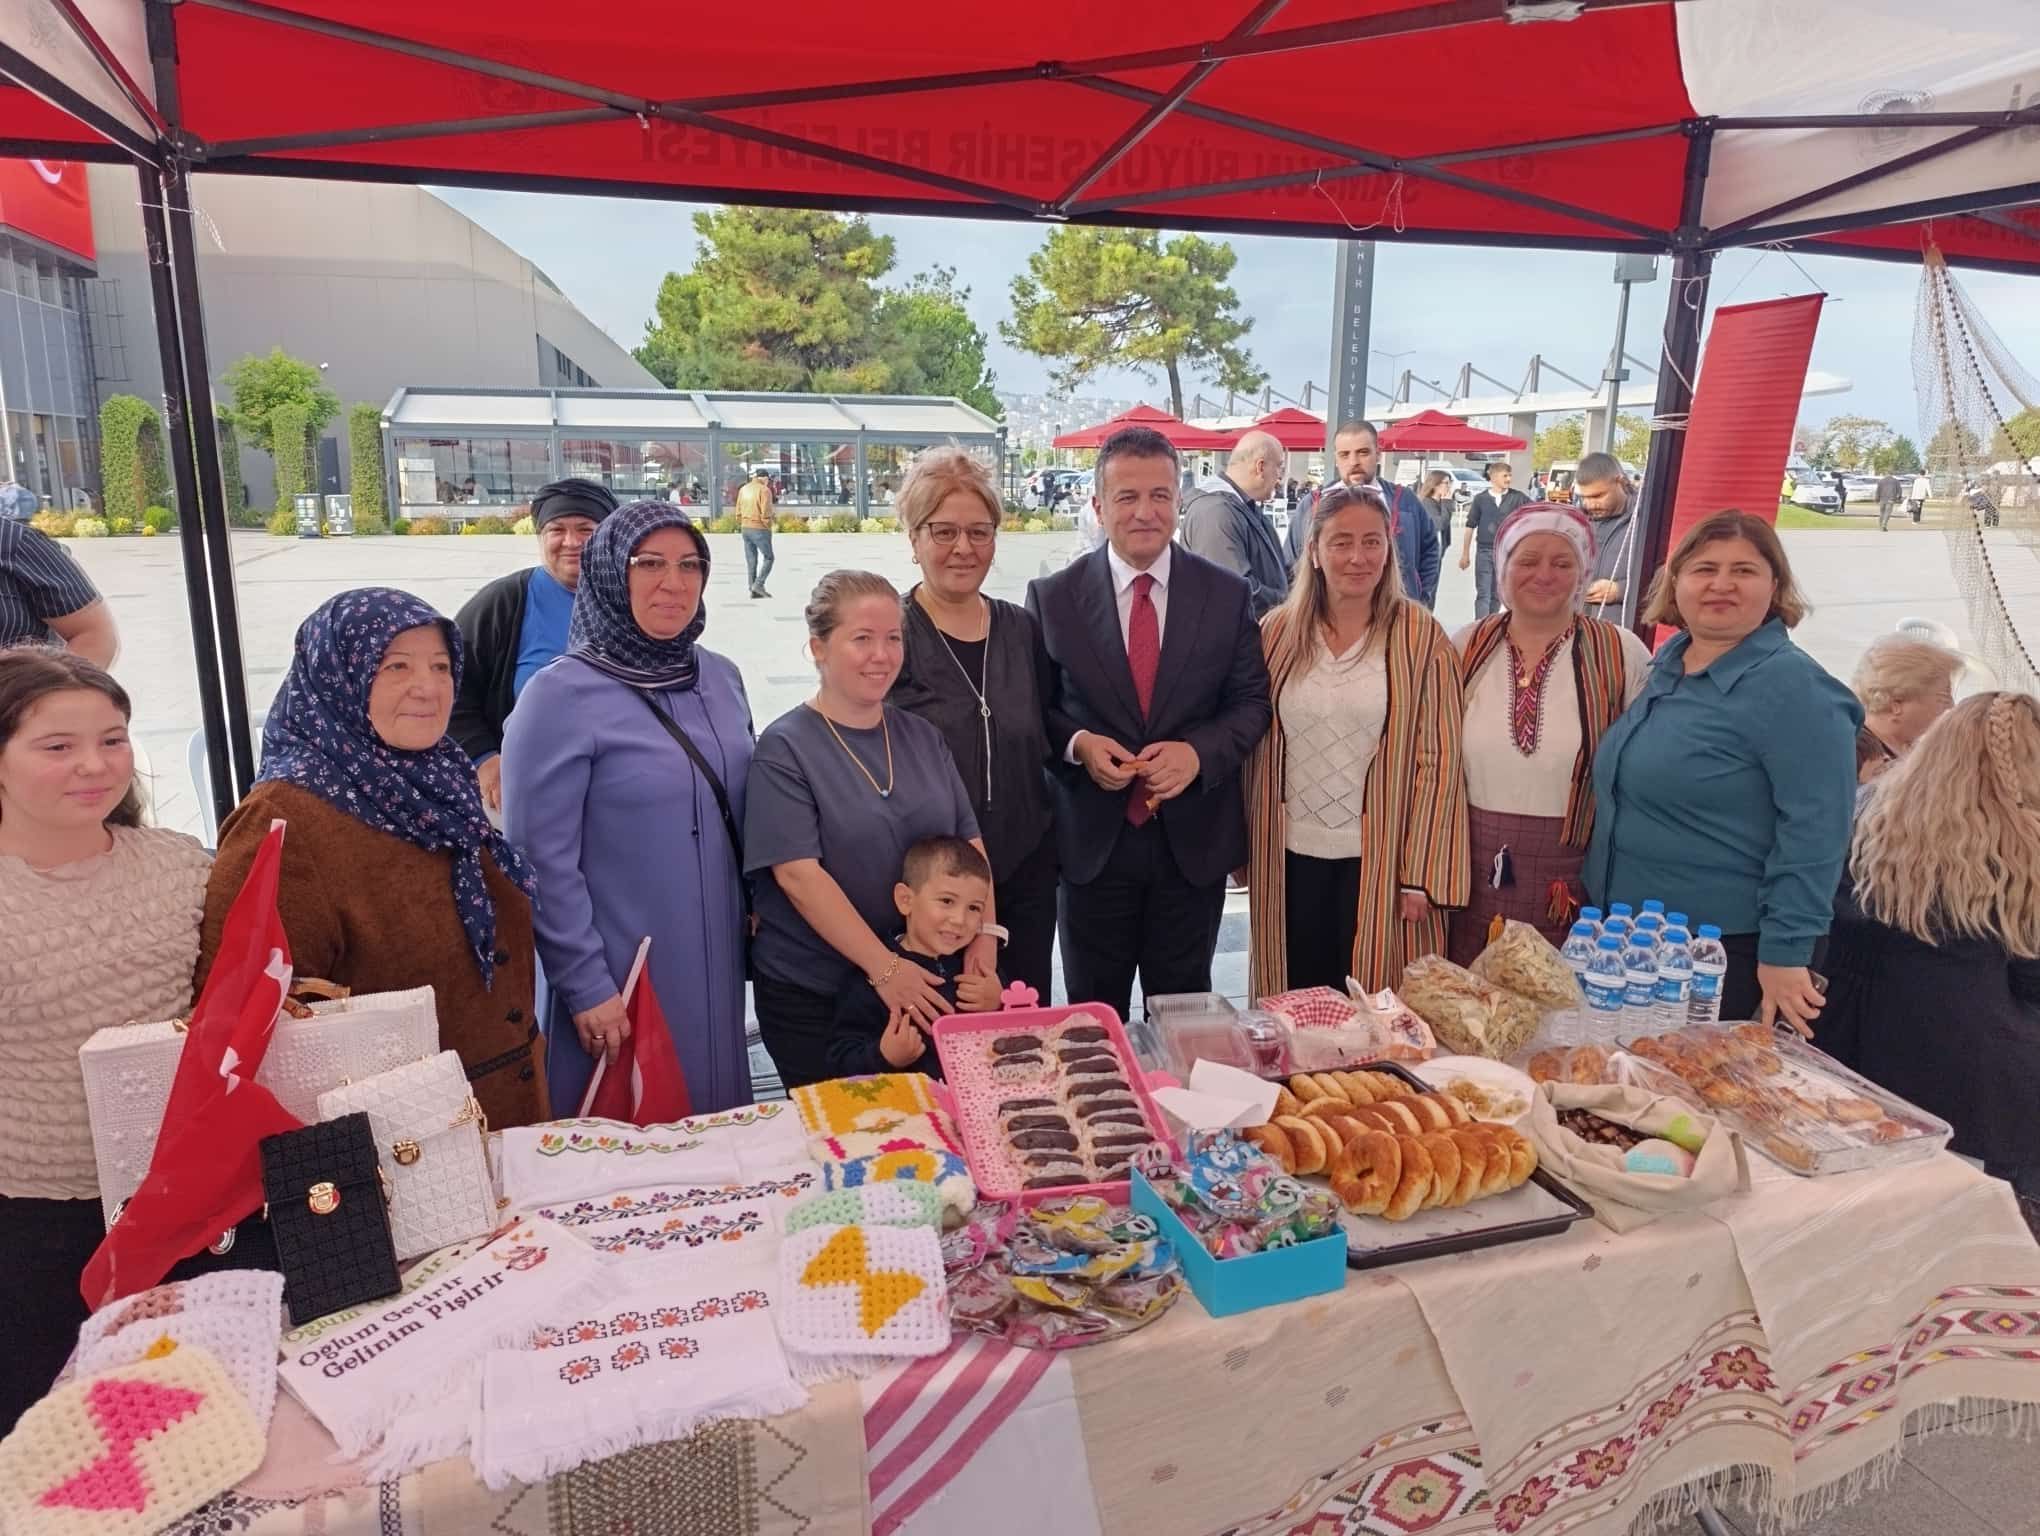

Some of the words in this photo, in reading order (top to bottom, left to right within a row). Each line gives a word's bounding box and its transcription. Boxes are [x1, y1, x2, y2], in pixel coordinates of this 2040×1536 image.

[322, 1320, 425, 1378] Gelinim
[426, 1271, 504, 1320] Pişirir
[382, 1275, 464, 1322] Getirir
